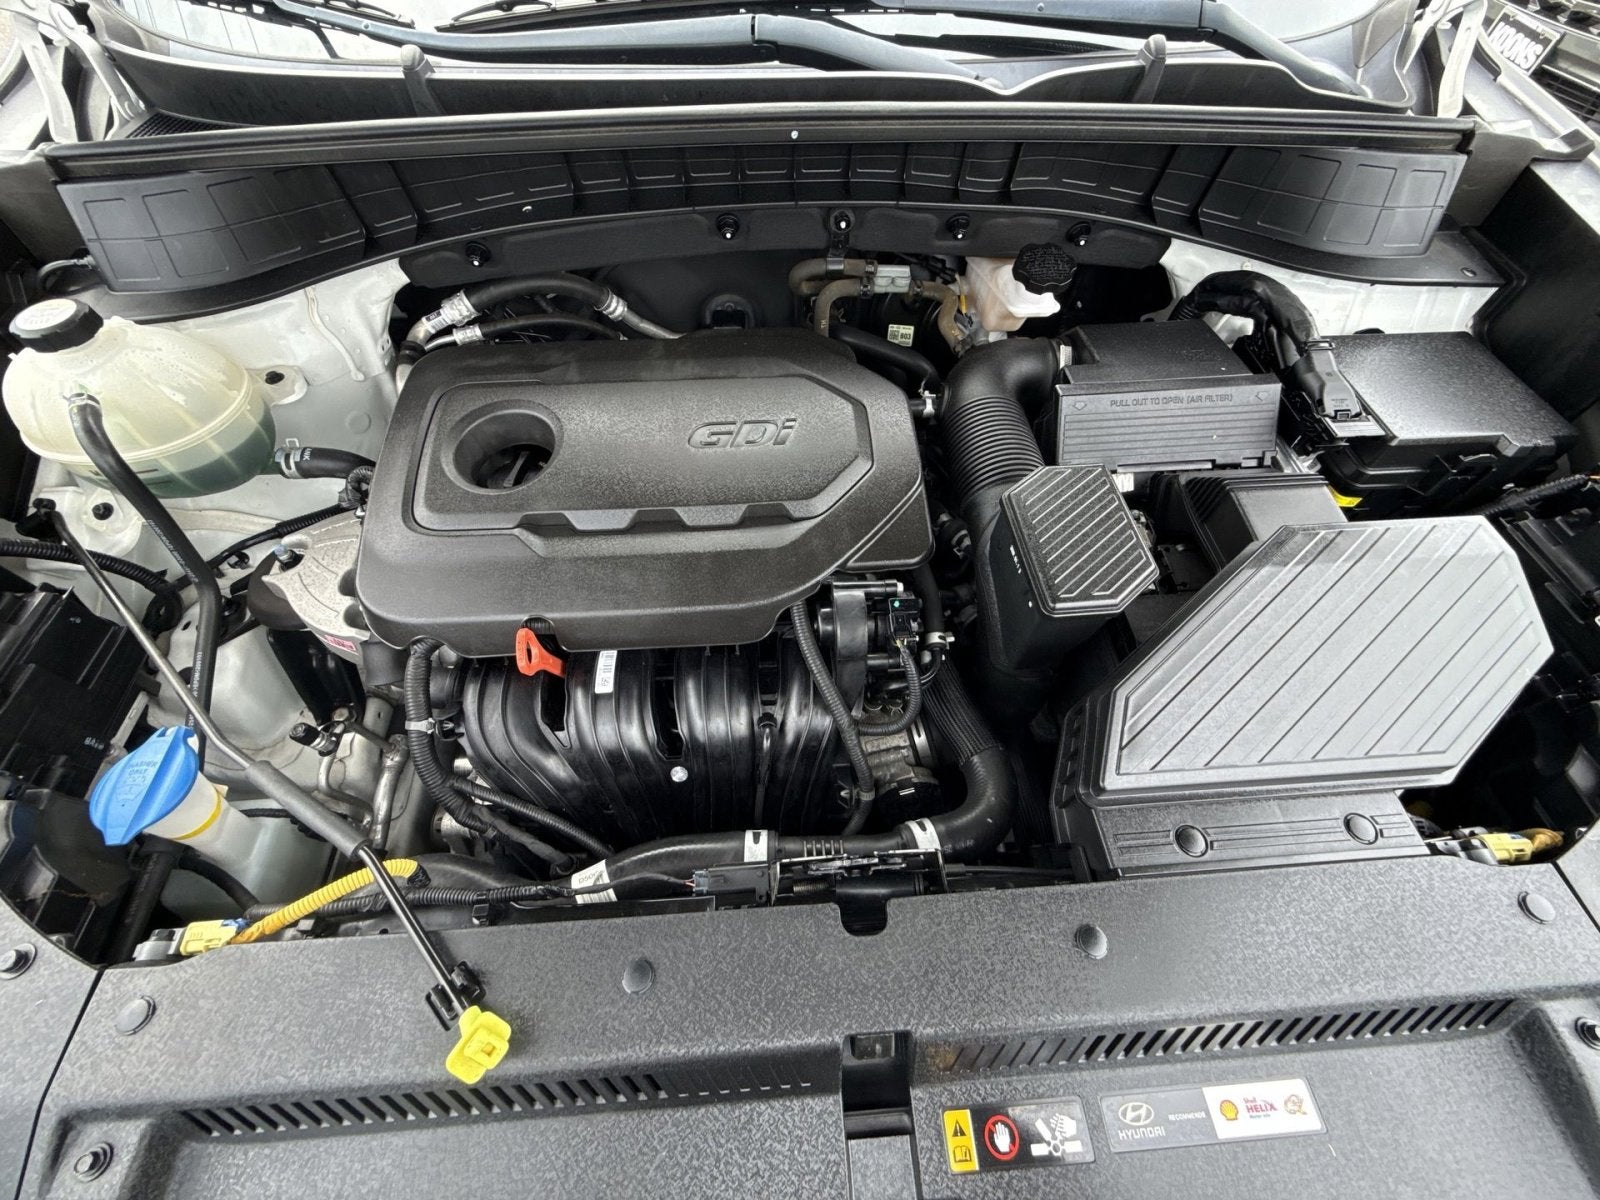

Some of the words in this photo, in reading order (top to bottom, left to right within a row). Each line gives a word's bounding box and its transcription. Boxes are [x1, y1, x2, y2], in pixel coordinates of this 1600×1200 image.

[1110, 399, 1130, 407] PULL
[1132, 398, 1148, 407] OUT
[1151, 397, 1160, 405] TO
[1162, 396, 1184, 405] OPEN
[1245, 1102, 1278, 1113] HELIX
[1118, 1126, 1166, 1140] HYUNDAI
